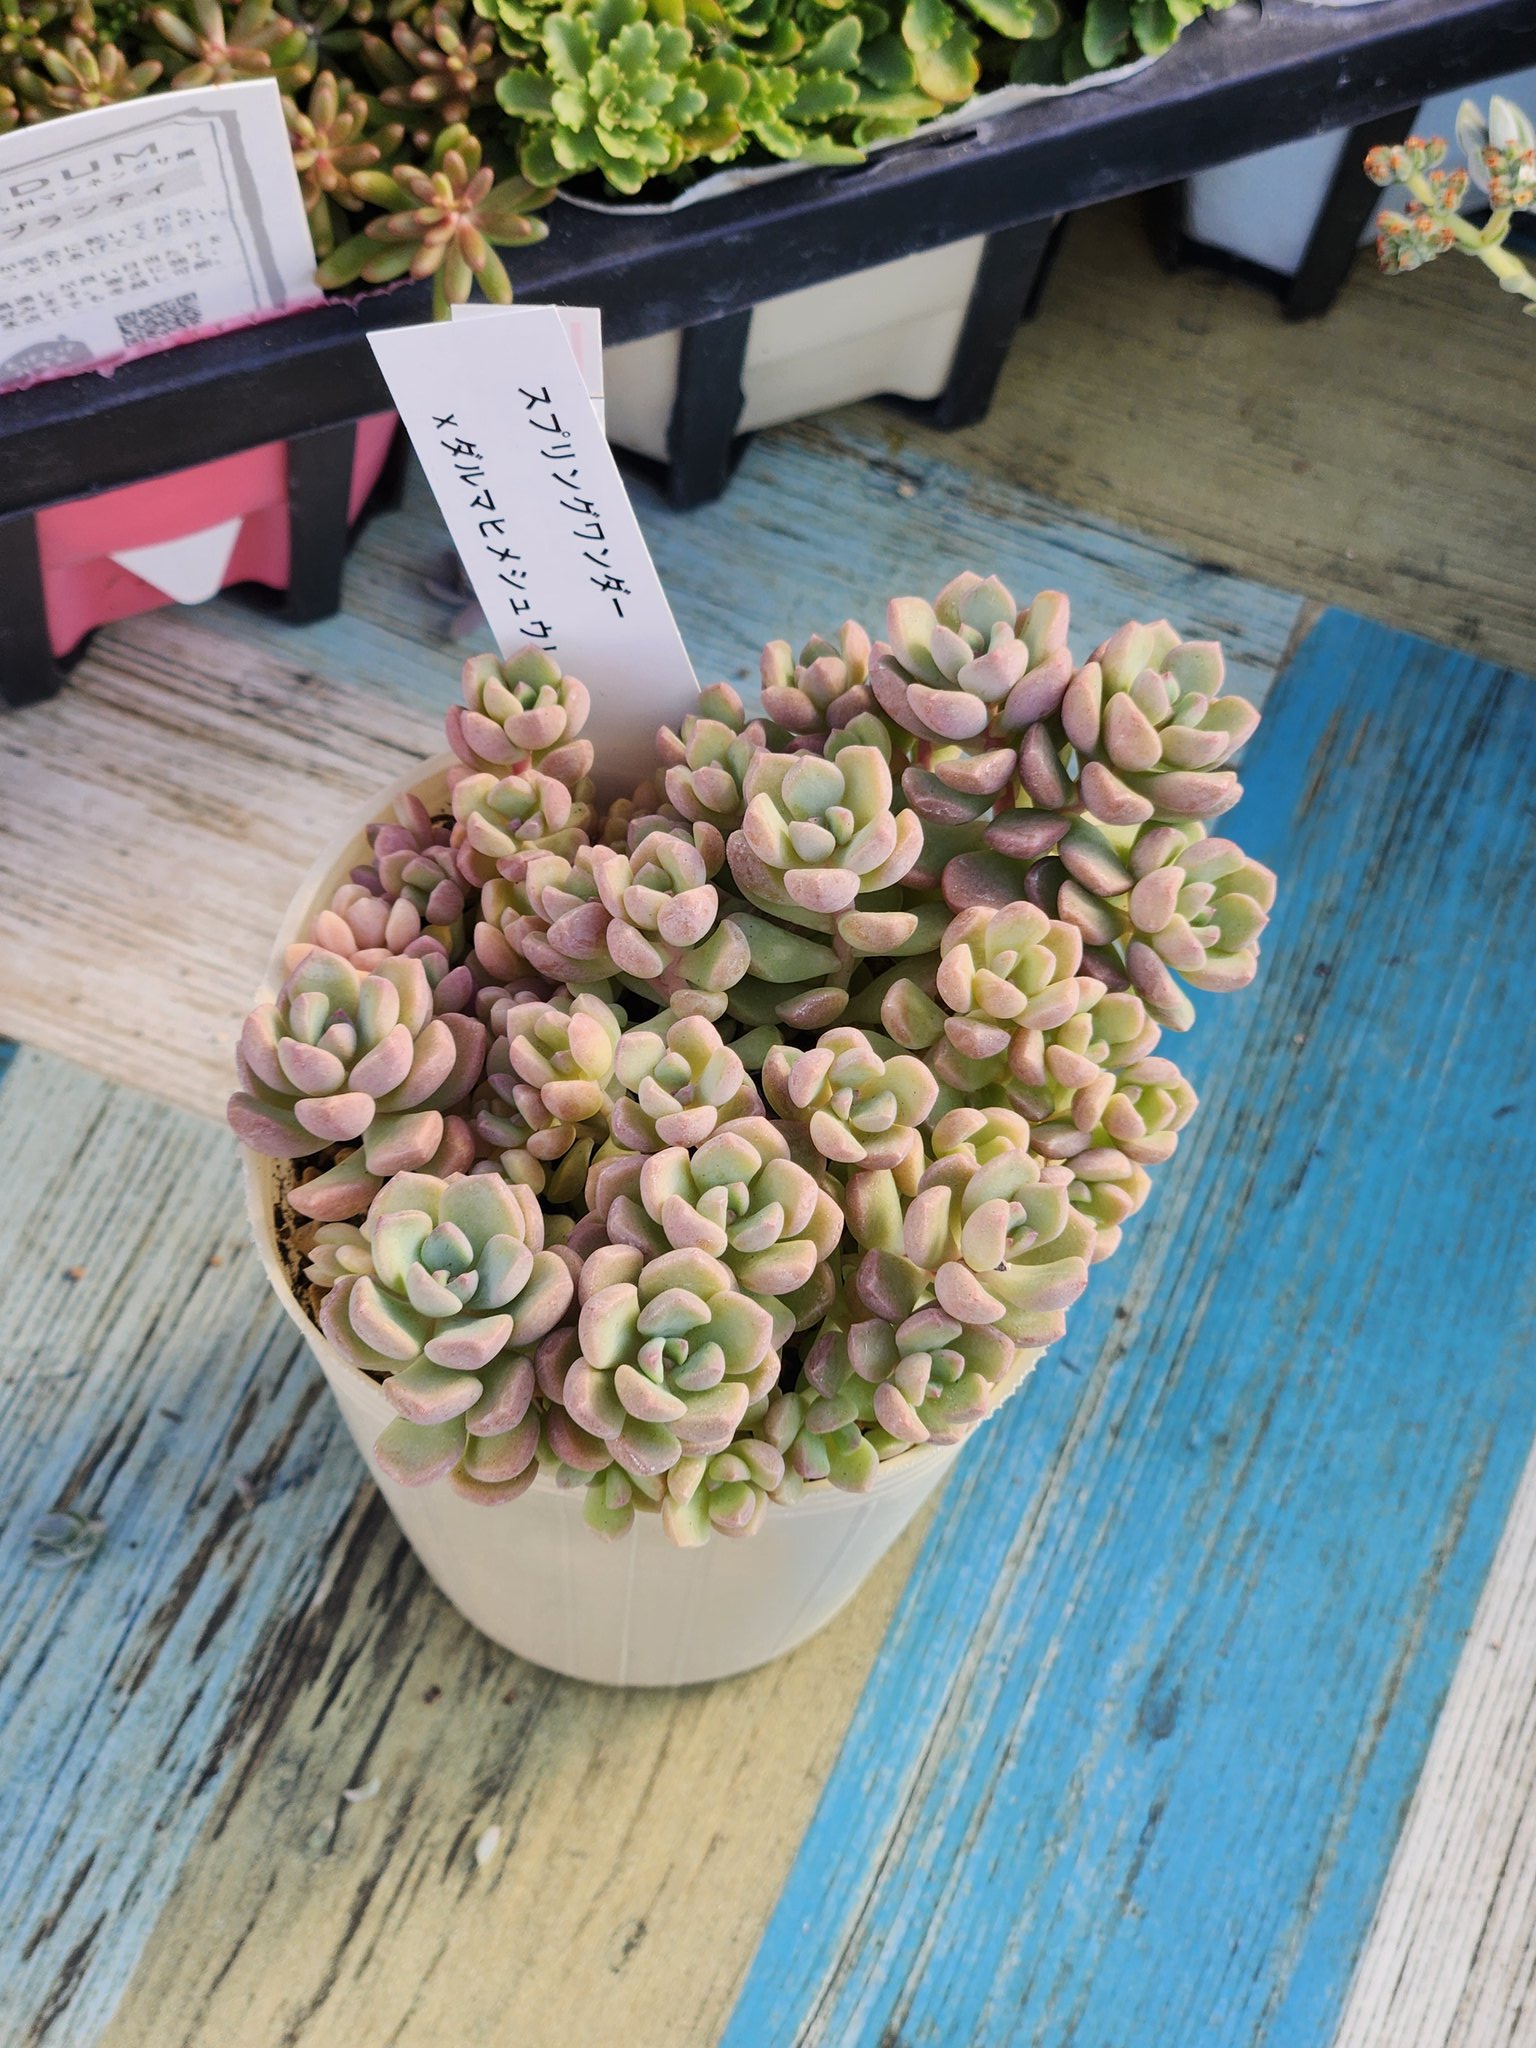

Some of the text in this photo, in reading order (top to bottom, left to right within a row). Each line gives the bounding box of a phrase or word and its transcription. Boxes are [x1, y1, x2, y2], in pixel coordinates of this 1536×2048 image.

[432, 413, 557, 651] ×ダルマヒメシュウ
[518, 386, 631, 618] スプリングワンダー
